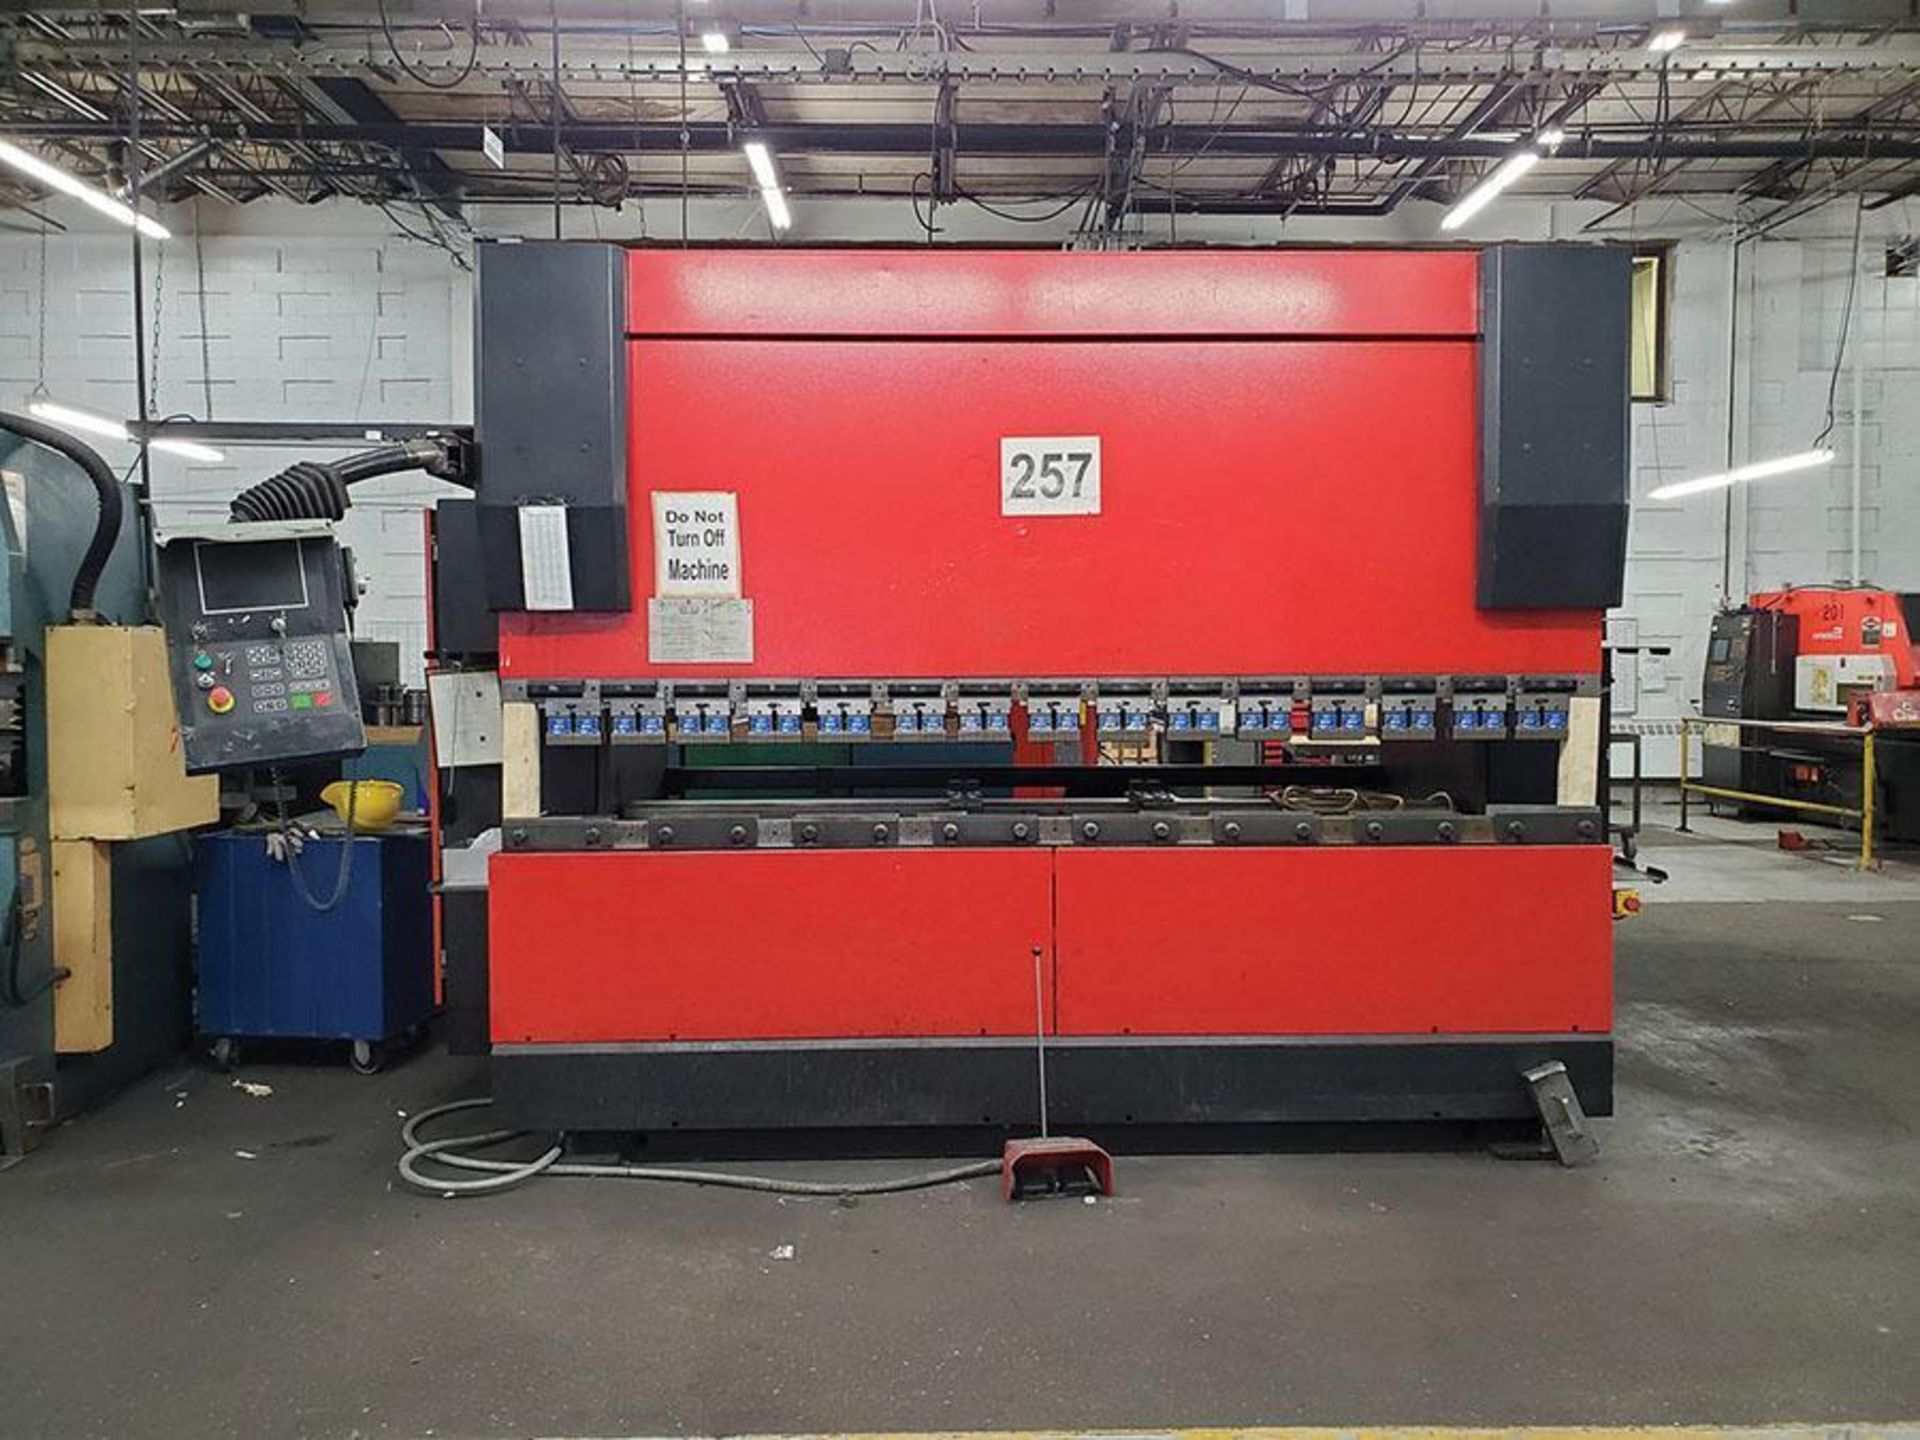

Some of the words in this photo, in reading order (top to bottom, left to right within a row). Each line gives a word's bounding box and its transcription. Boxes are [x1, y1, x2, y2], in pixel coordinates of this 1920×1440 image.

[1010, 452, 1092, 498] 257
[665, 510, 689, 524] Do
[695, 510, 724, 523] Not
[667, 529, 699, 547] Turn
[703, 528, 725, 547] Off
[668, 558, 729, 581] Machine
